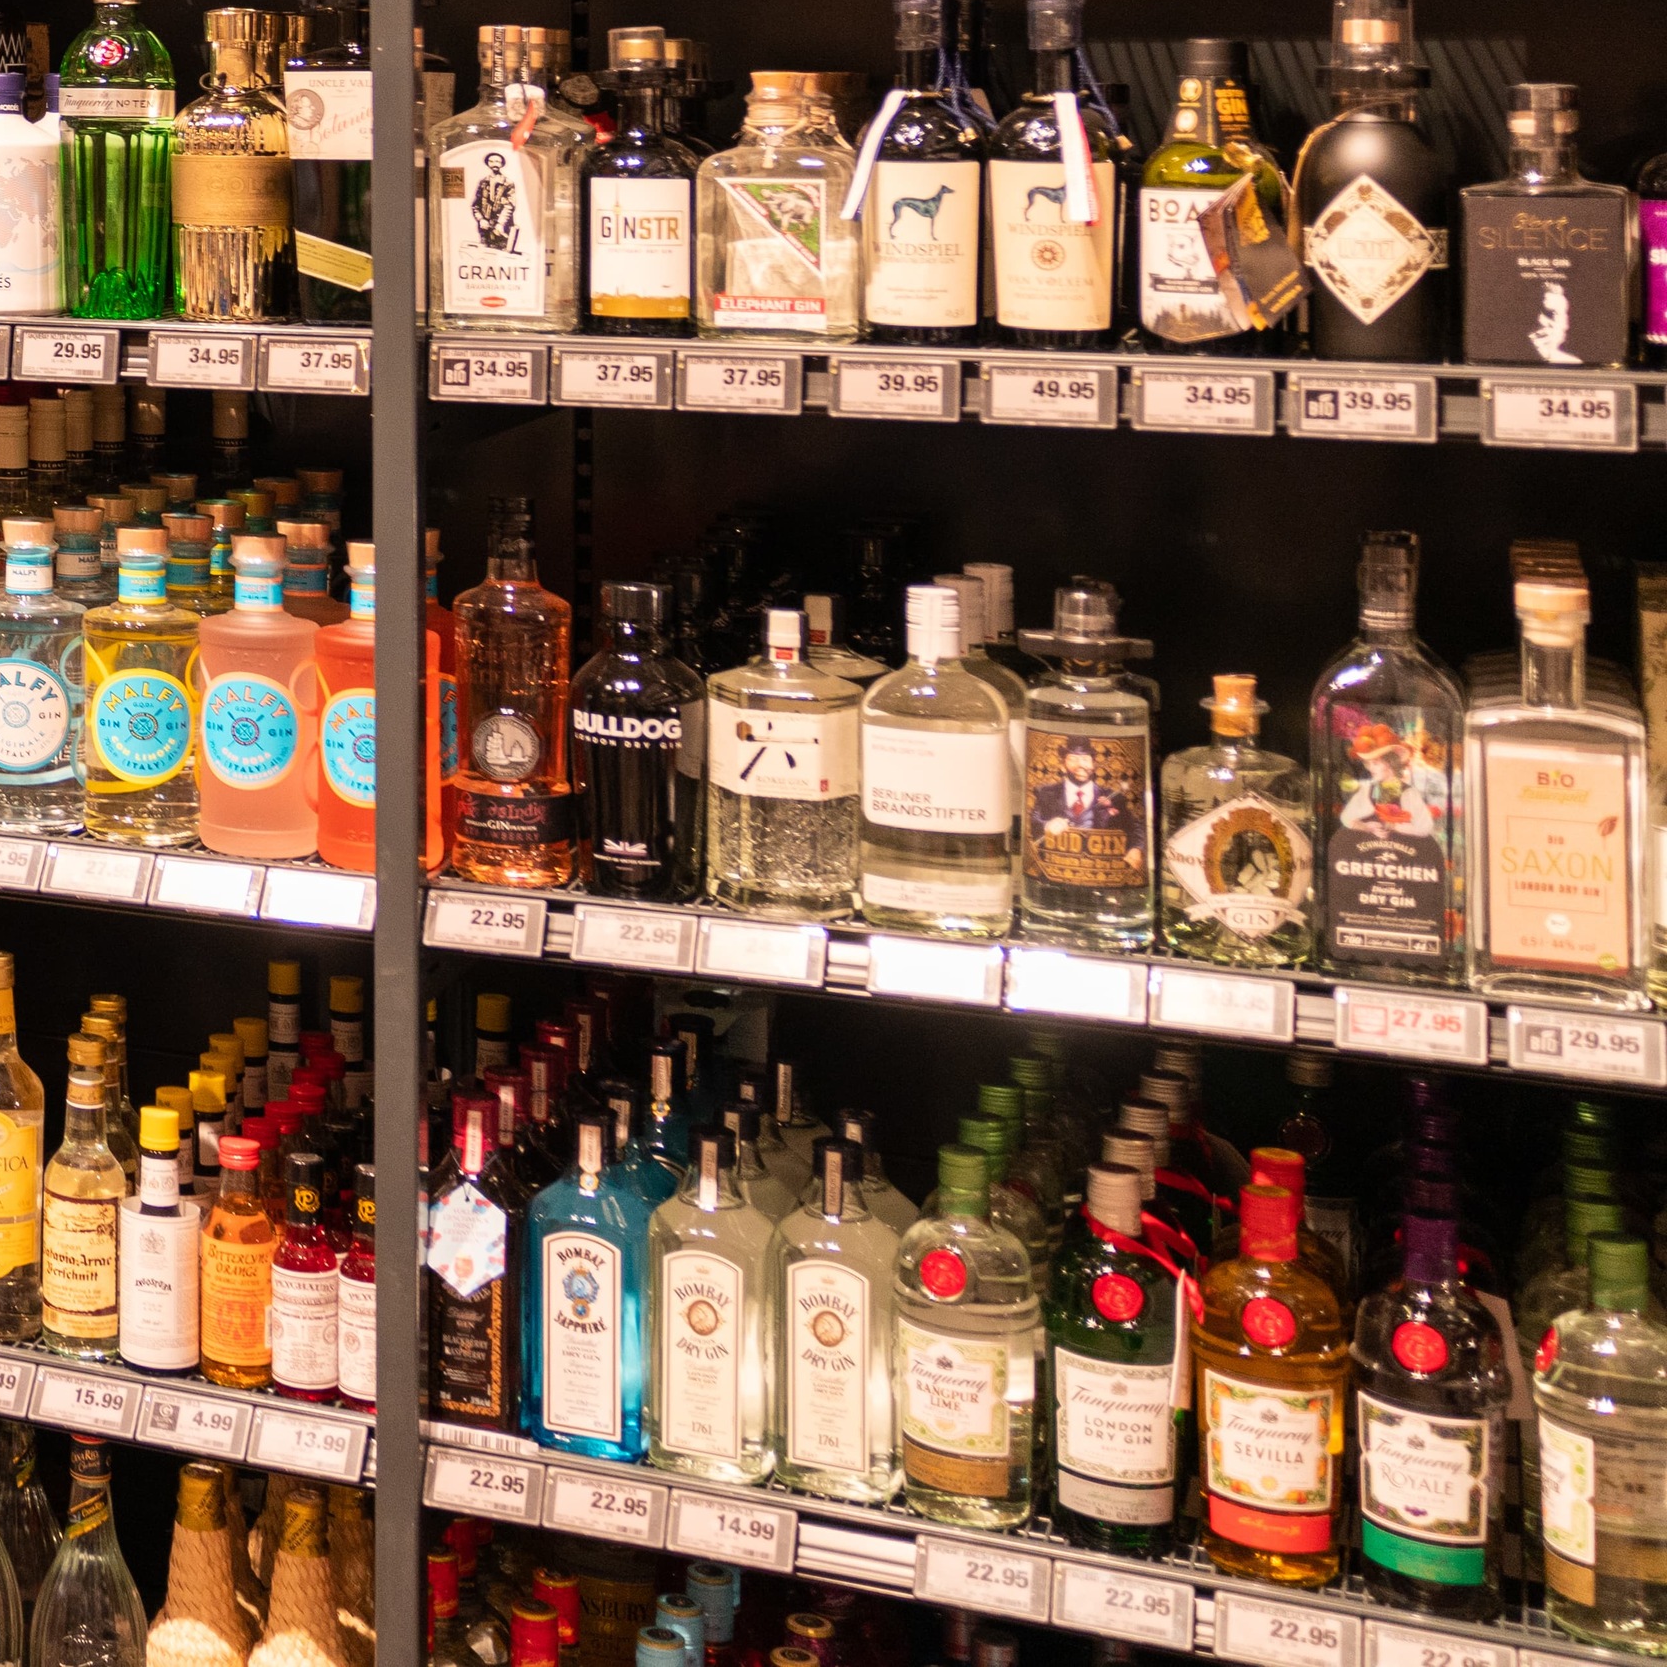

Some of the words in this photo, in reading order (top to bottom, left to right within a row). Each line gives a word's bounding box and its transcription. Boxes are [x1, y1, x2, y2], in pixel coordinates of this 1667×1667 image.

[1479, 228, 1608, 252] SILENCE
[459, 264, 530, 282] GRANIT
[721, 297, 784, 314] ELEPHANT
[789, 297, 824, 314] GIN
[53, 341, 102, 361] 29.95
[189, 347, 239, 365] 34.95
[301, 351, 354, 370] 37.95
[597, 365, 653, 385] 37.95
[878, 374, 939, 394] 39.95
[1033, 381, 1095, 400] 49.95
[1344, 392, 1412, 412] 39.95
[103, 681, 185, 714] MALFY
[210, 685, 289, 719] MALFY
[574, 709, 681, 740] BULLDOG
[872, 787, 931, 805] BERLINER
[872, 800, 987, 822] BRANDSTIFTER
[1088, 832, 1128, 856] GIN
[1336, 859, 1439, 884] GRETCHEN
[1500, 845, 1613, 882] SAXON
[471, 909, 526, 930] 22.95
[1232, 910, 1270, 926] GIN
[1392, 1008, 1462, 1034] 27.95
[1569, 1028, 1641, 1055] 29.95
[557, 1245, 606, 1270] BOMBAY
[673, 1283, 732, 1311] BOMBAY
[554, 1314, 607, 1336] SAPPHIRE
[74, 1387, 124, 1410] 15.99
[915, 1381, 979, 1404] RANGPUR
[929, 1394, 961, 1412] LIME
[192, 1410, 233, 1431] 4.99
[1084, 1414, 1152, 1435] LONDON
[1235, 1441, 1305, 1466] SEVILLA
[1380, 1464, 1455, 1496] ROYALE
[716, 1514, 775, 1542] 14.99
